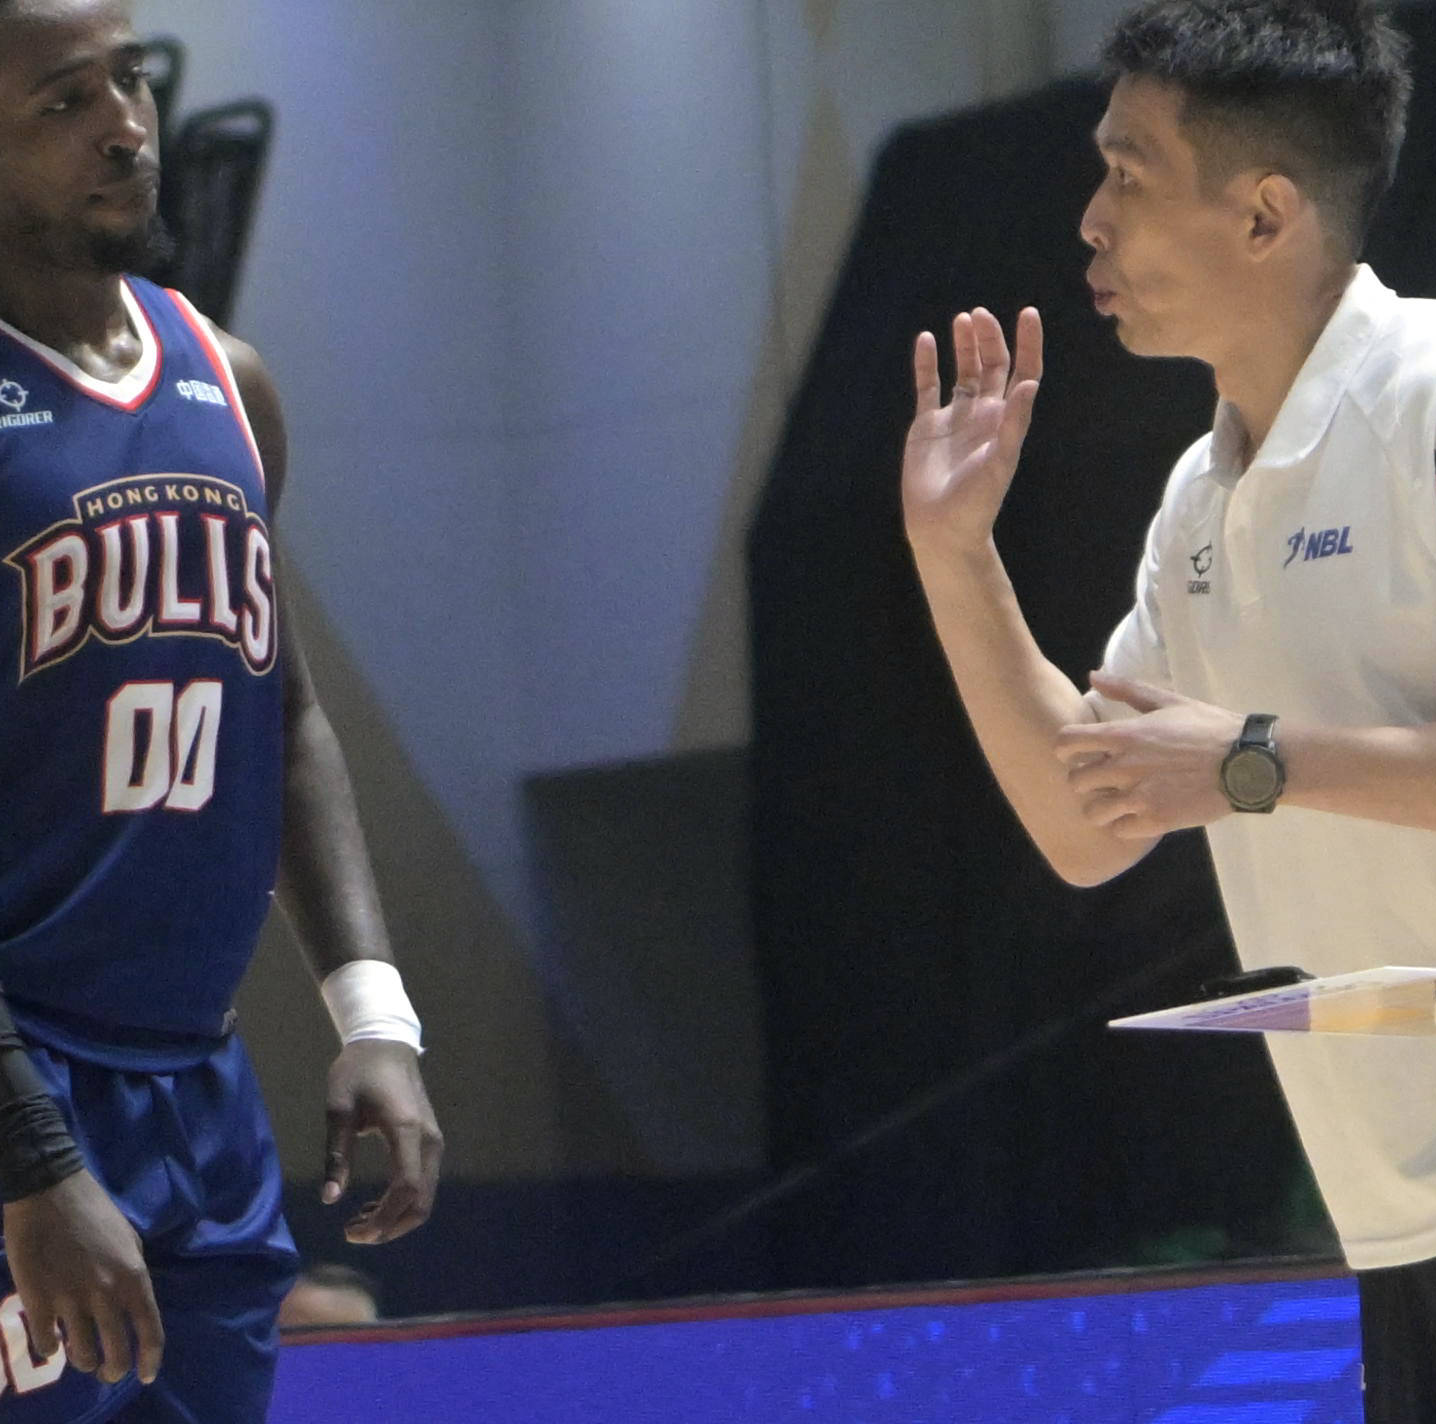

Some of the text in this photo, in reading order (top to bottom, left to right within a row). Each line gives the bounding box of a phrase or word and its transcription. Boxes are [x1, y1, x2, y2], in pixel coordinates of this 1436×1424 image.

[86, 484, 241, 517] HONG KONG
[1304, 527, 1353, 562] NBL
[29, 513, 274, 663] BULLS
[104, 680, 222, 814] 00
